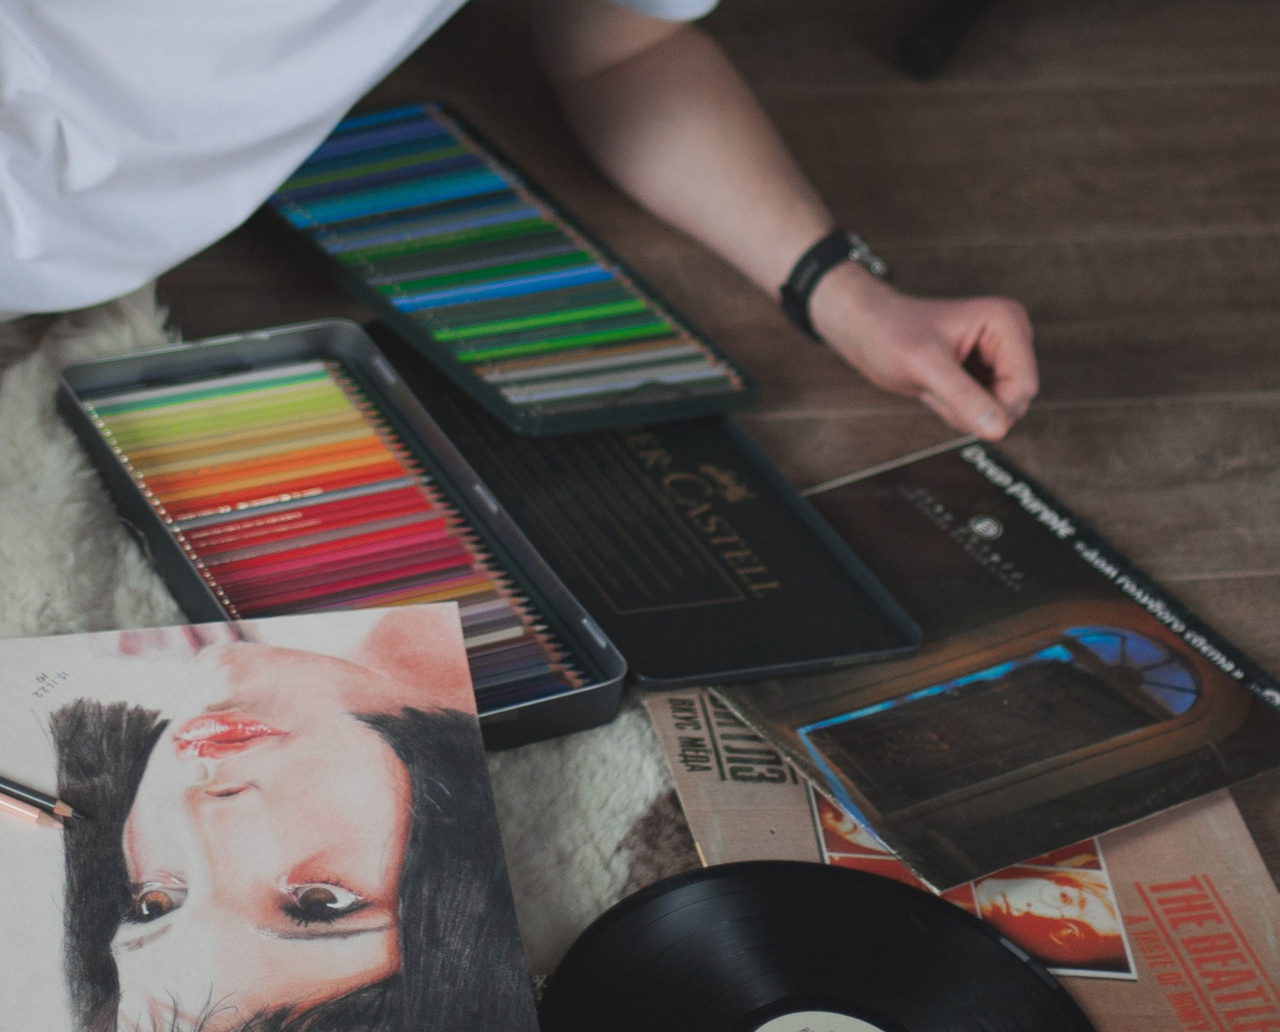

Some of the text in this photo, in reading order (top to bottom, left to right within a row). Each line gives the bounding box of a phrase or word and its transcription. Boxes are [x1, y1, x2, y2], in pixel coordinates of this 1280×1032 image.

[960, 444, 1014, 489] Deep
[1005, 481, 1077, 540] Purple
[669, 698, 703, 731] ВКУС
[708, 694, 787, 783] ТЛЗ
[1149, 874, 1222, 930] THE
